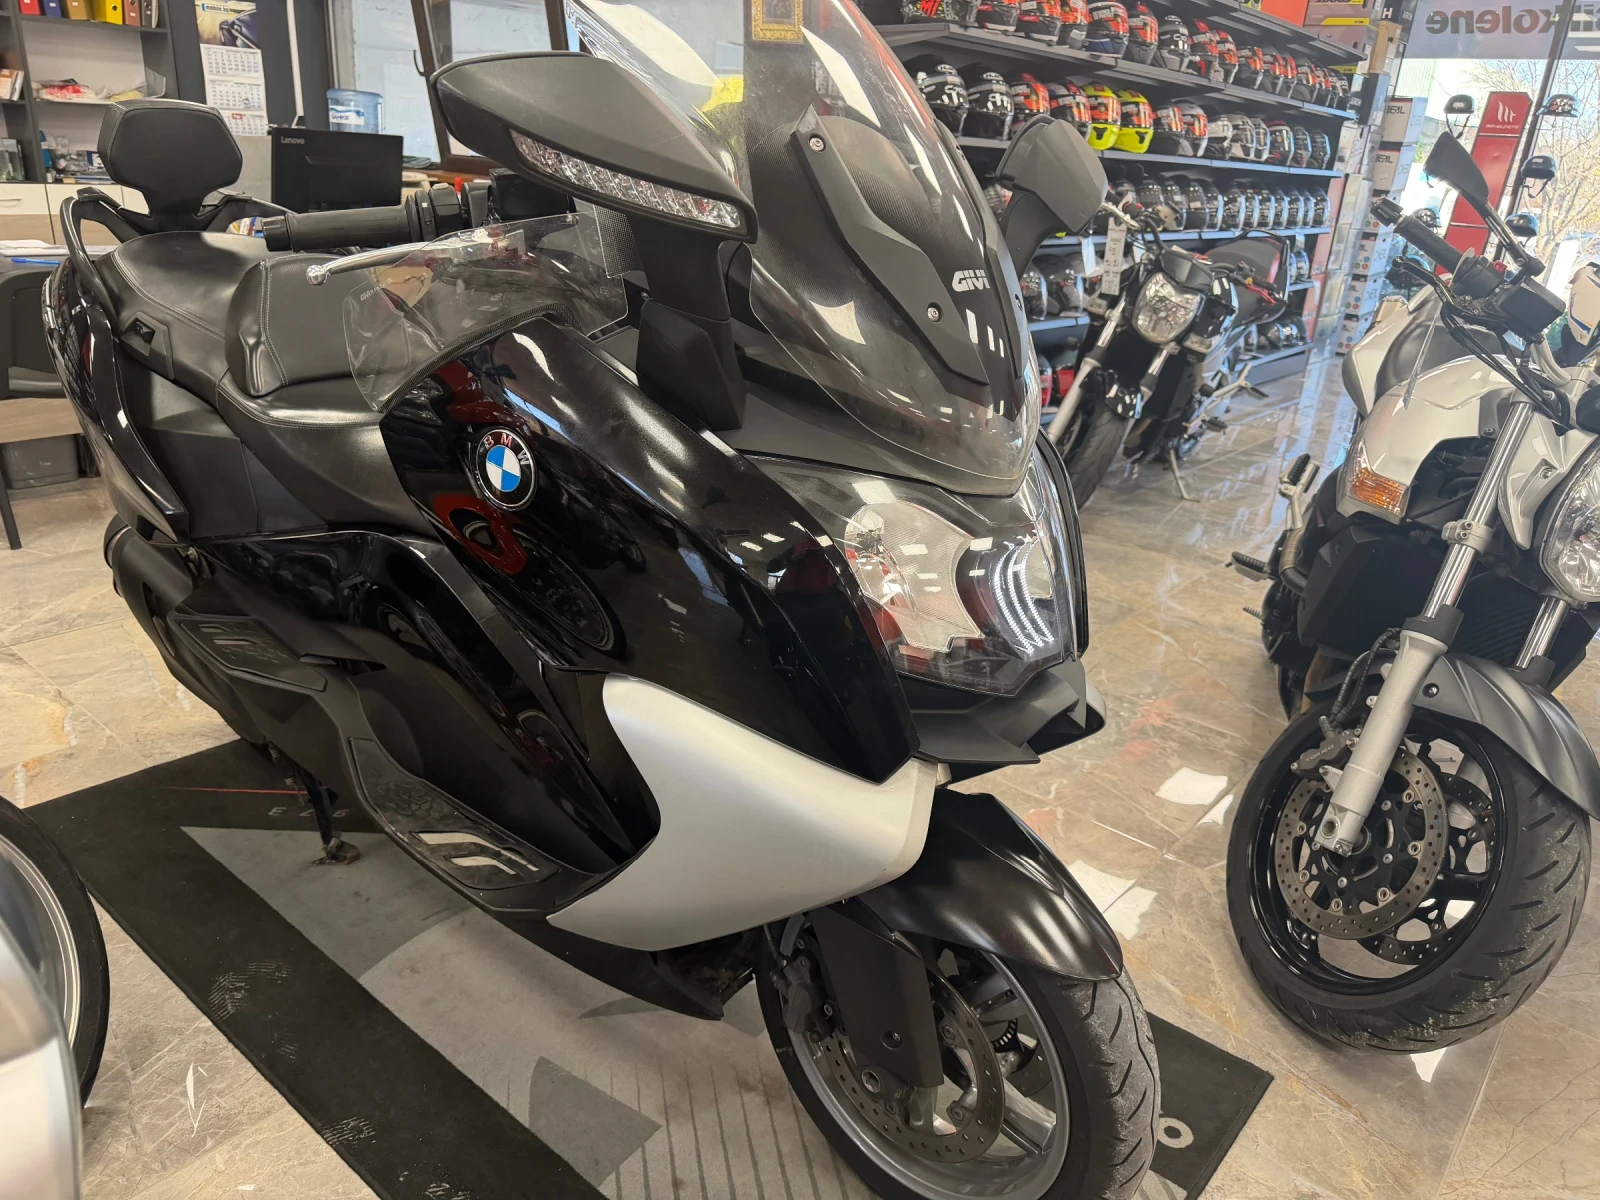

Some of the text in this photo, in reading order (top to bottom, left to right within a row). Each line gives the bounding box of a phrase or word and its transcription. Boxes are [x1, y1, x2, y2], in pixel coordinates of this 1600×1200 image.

[281, 136, 305, 145] Lenovo
[951, 269, 991, 292] GIVI
[483, 432, 530, 466] BMW
